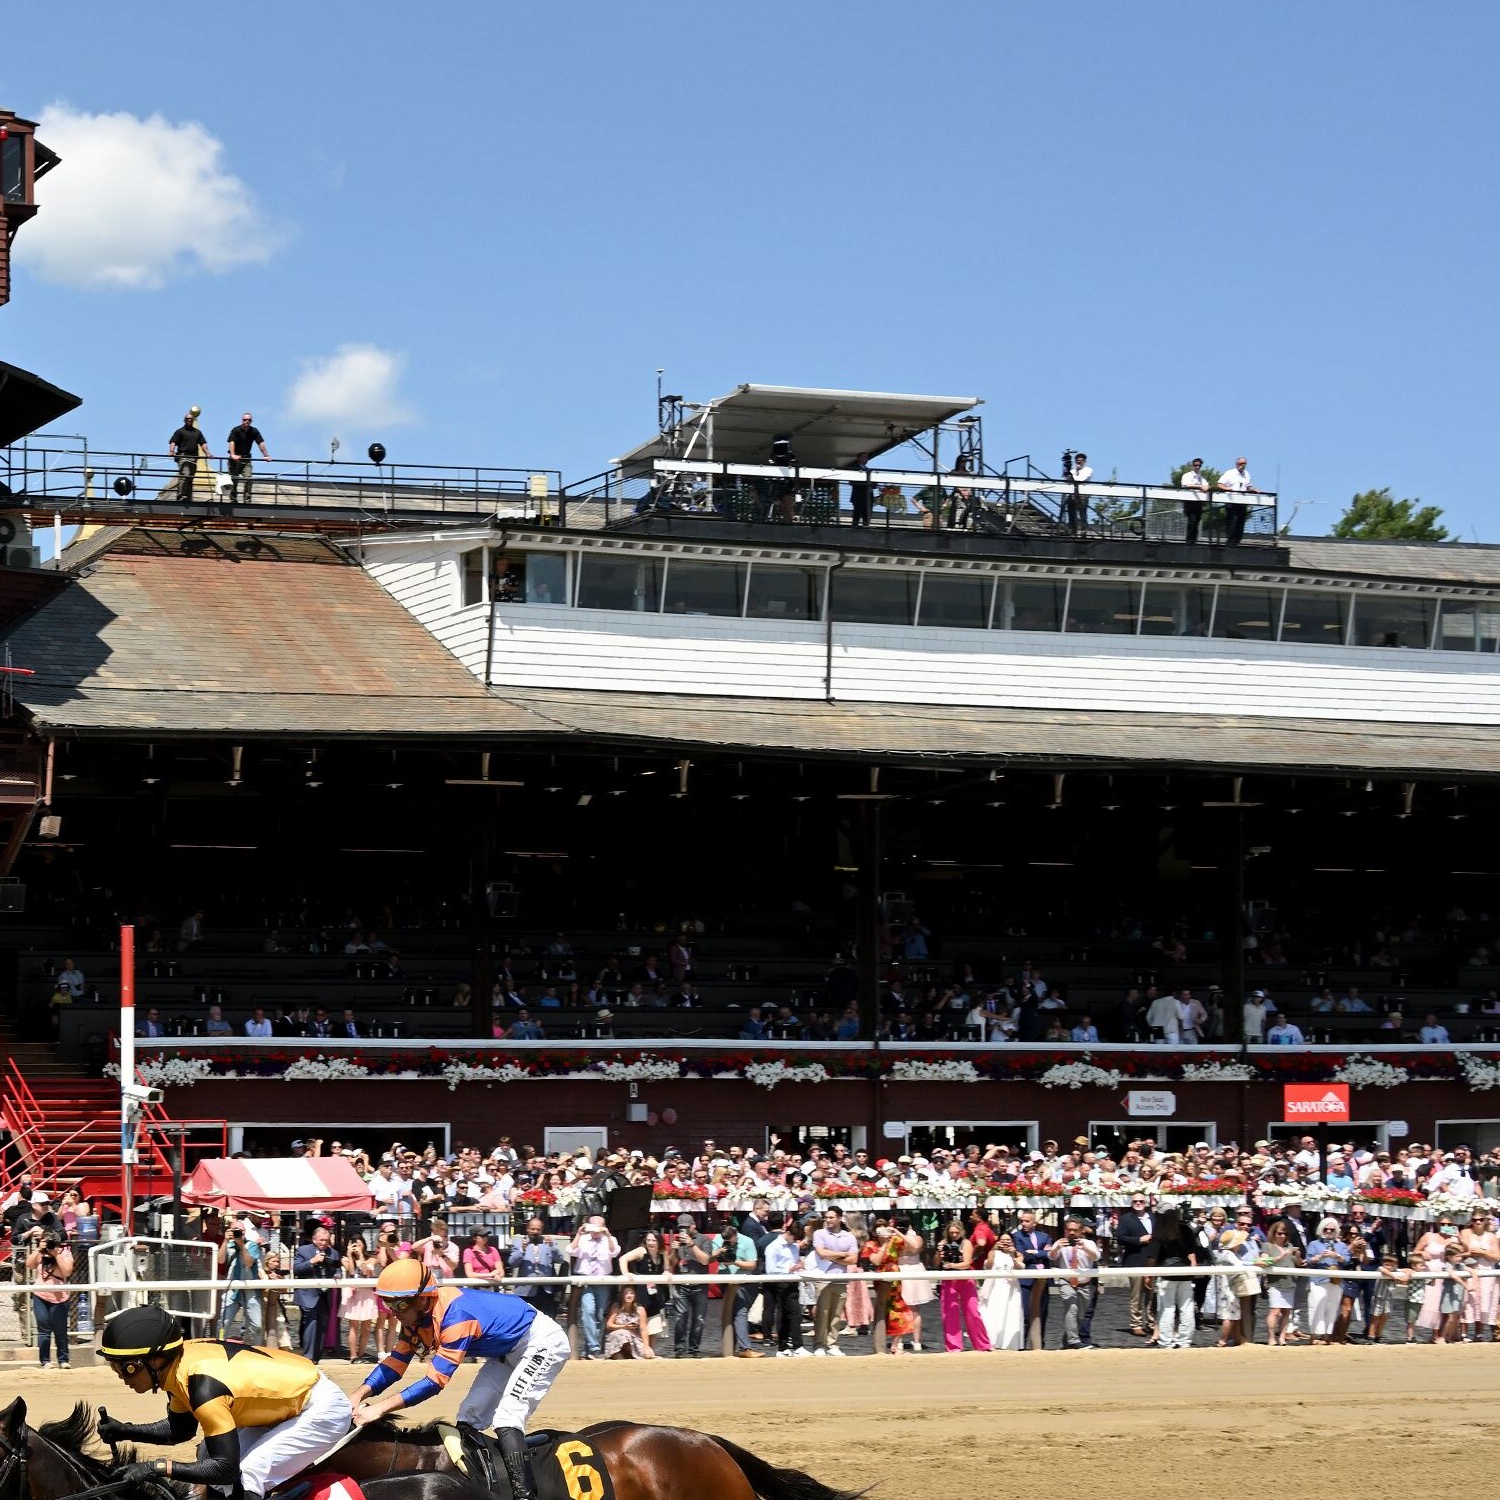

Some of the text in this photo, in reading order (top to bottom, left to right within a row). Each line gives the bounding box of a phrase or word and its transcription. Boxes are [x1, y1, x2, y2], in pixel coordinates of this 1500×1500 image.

[1286, 1101, 1347, 1113] SARATOGA
[510, 1376, 528, 1401] JEFF
[555, 1440, 605, 1500] 6
